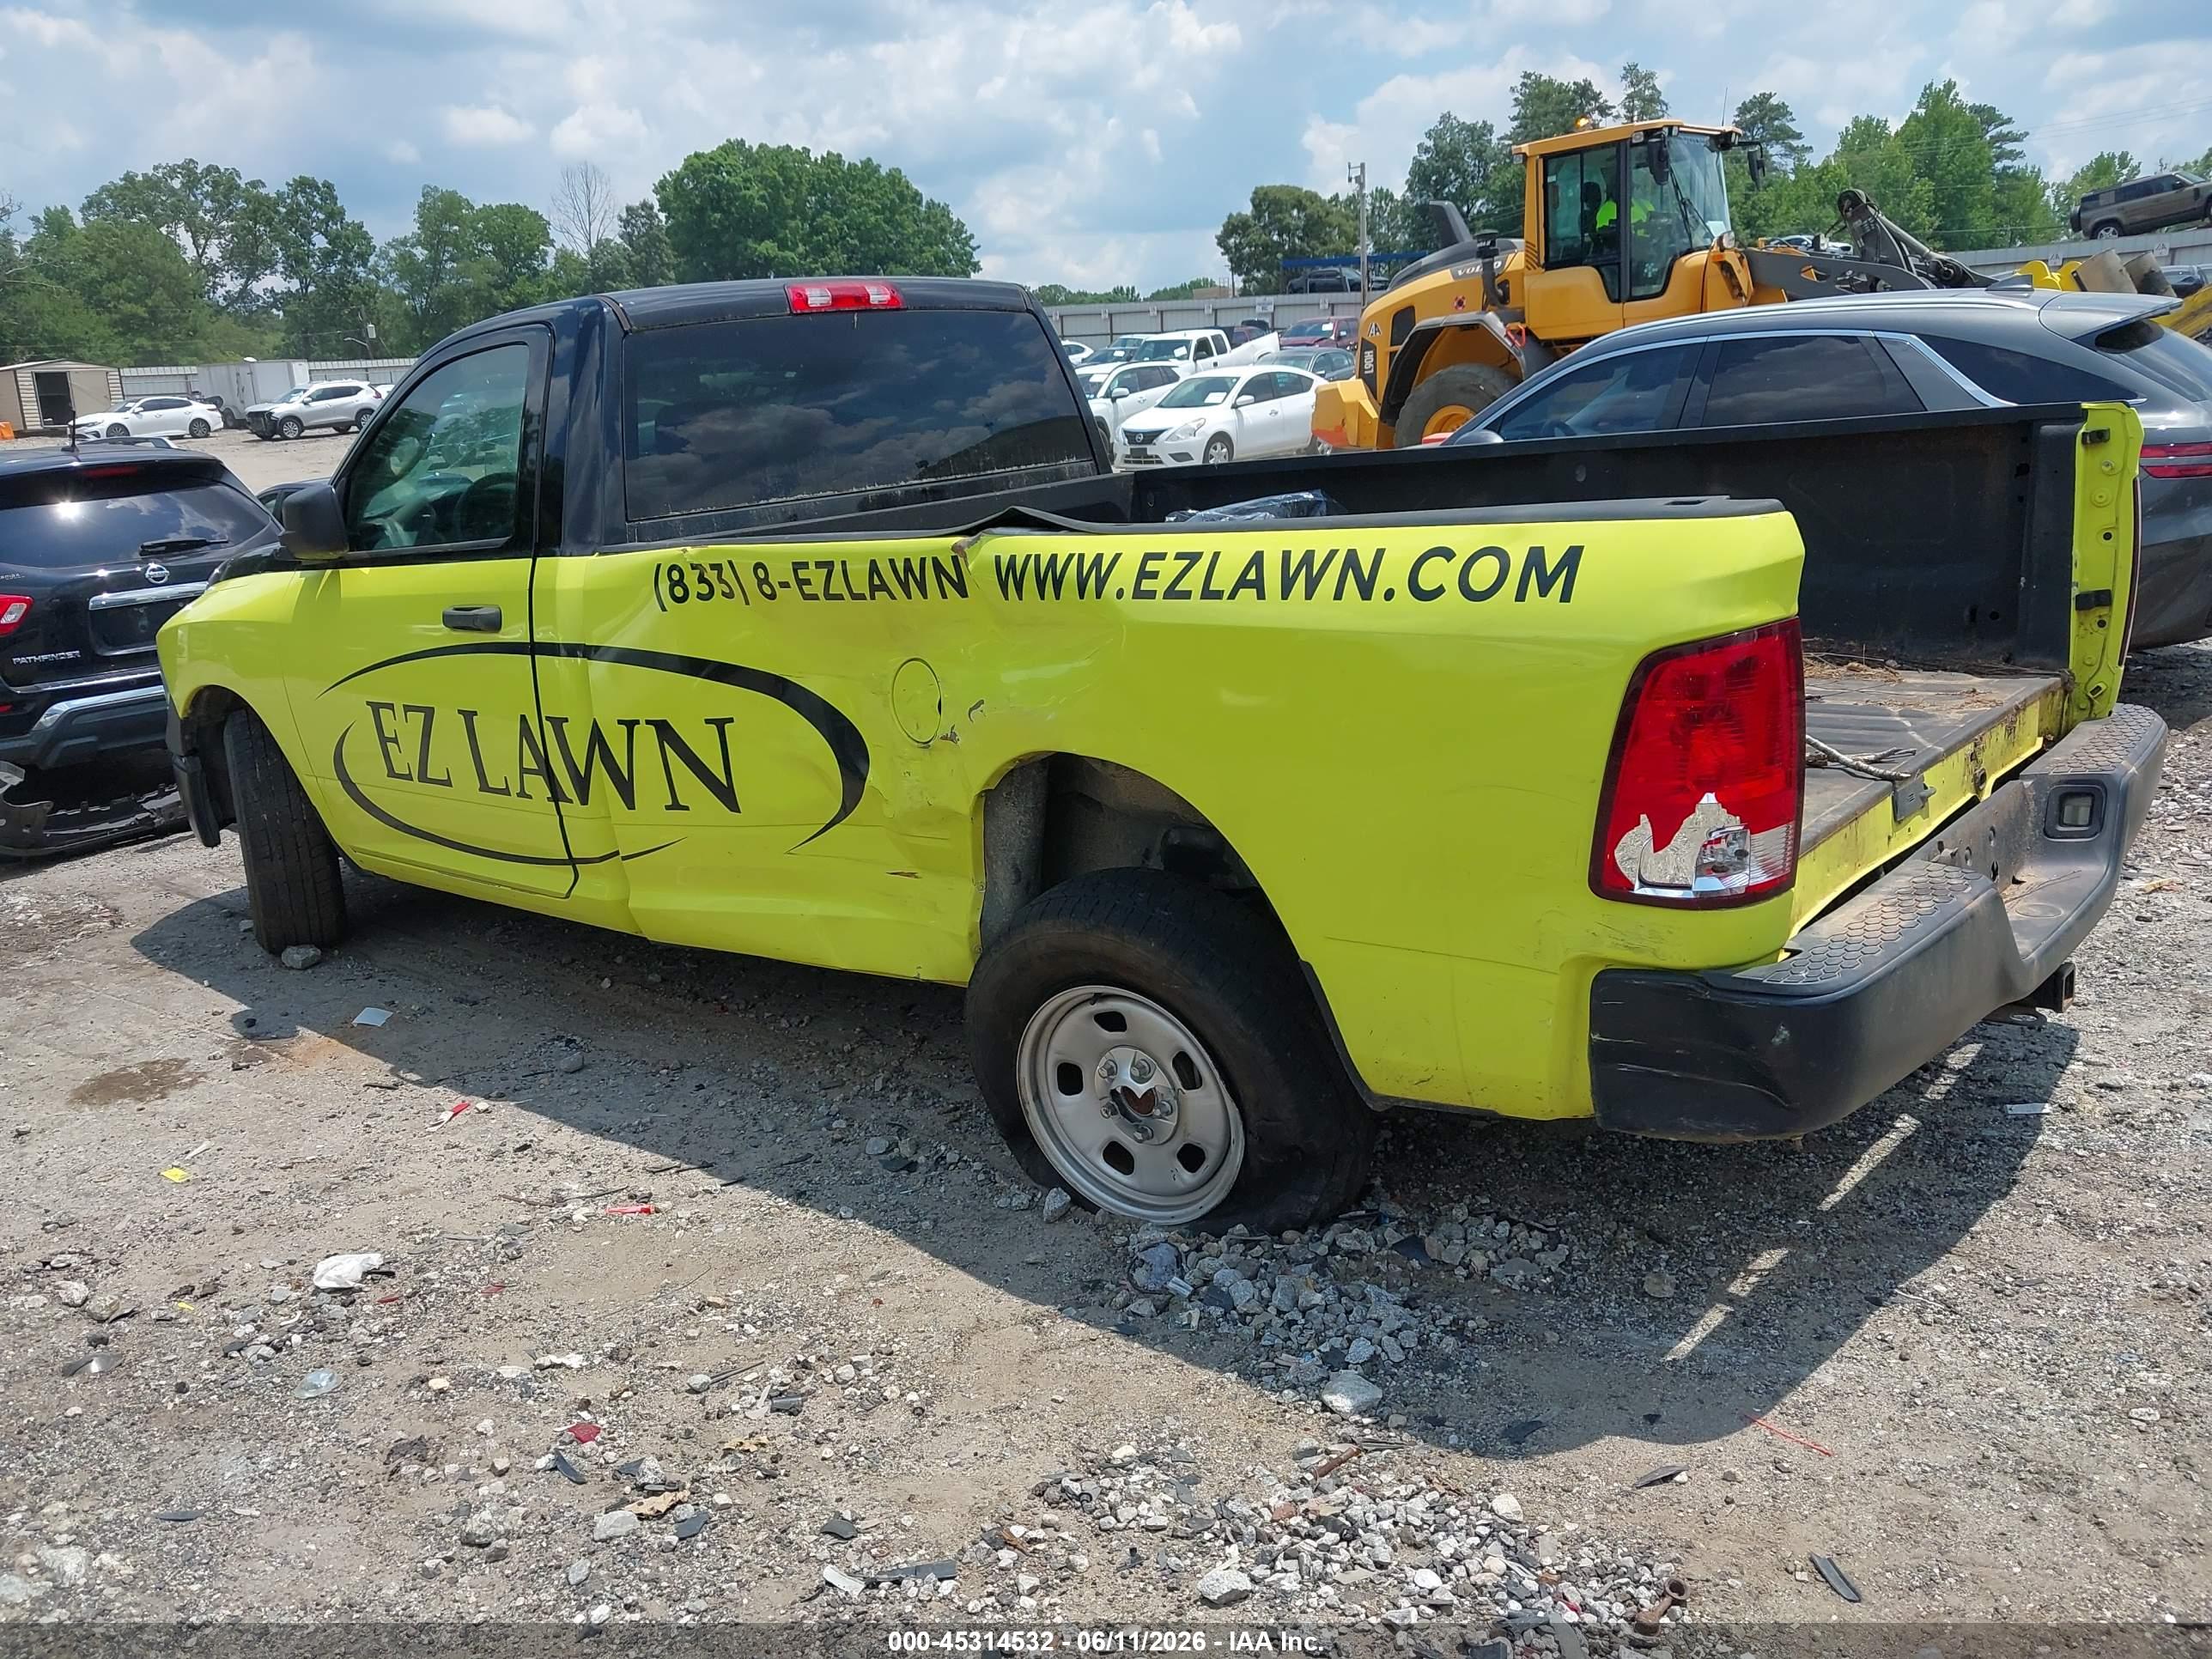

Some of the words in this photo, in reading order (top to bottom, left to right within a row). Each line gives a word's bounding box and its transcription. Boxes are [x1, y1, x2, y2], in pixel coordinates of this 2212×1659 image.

[1457, 261, 1502, 276] VOLO
[753, 555, 969, 601] 8-EZLAWN
[994, 545, 1584, 603] WWW.EZLAWN.COM
[12, 651, 81, 665] PATHFINDER
[366, 701, 453, 787] EZ
[457, 708, 741, 814] LAWN
